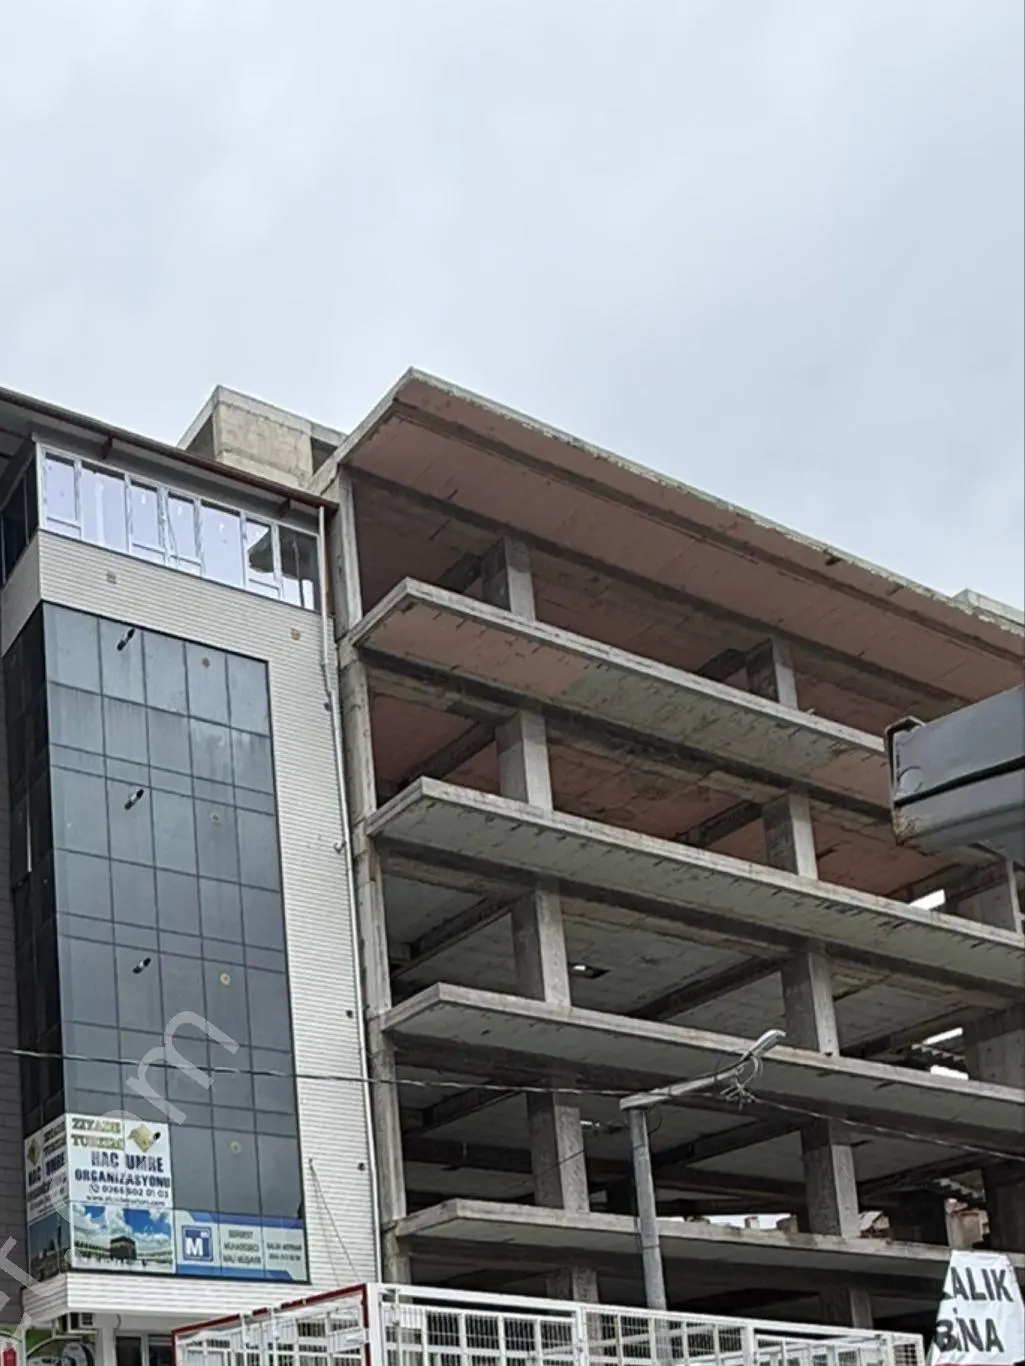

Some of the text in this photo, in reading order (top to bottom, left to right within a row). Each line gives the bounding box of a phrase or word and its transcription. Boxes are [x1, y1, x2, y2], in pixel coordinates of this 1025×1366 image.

[91, 1151, 164, 1173] HAC UMRE
[950, 1266, 1014, 1302] ALIK
